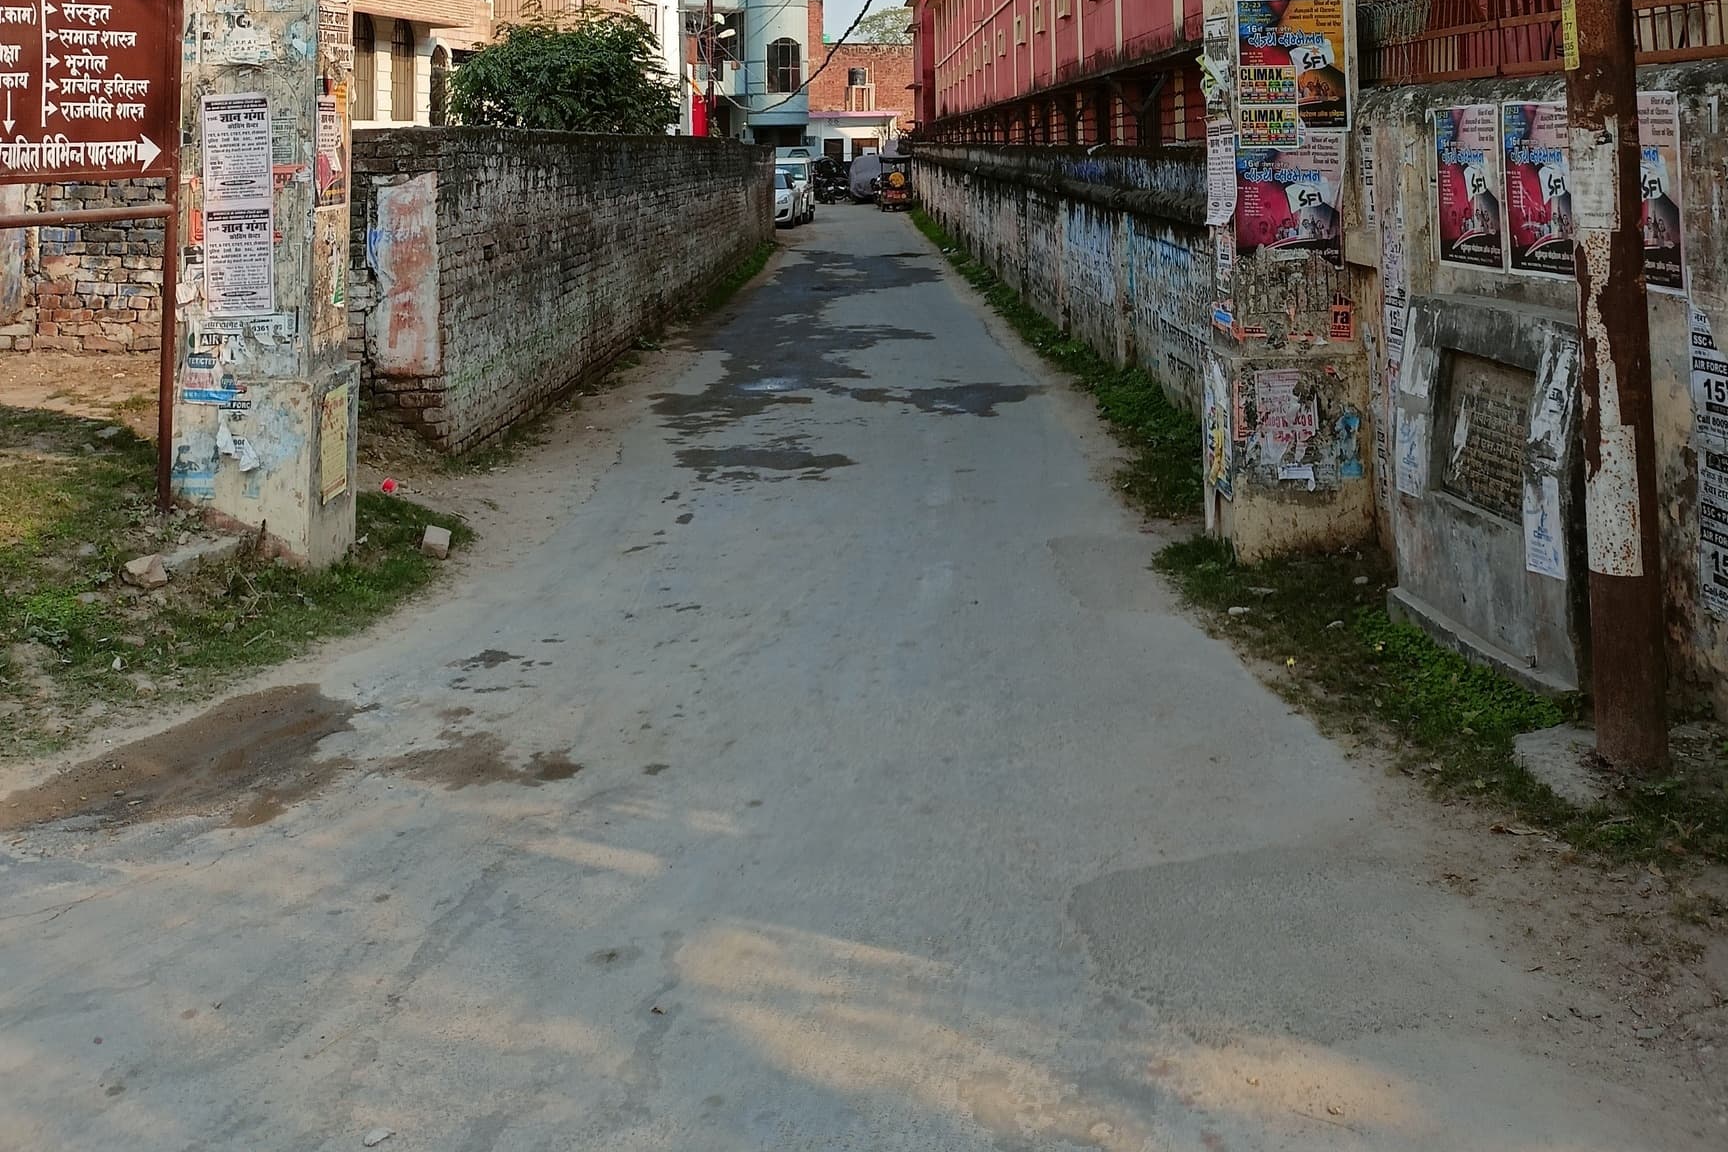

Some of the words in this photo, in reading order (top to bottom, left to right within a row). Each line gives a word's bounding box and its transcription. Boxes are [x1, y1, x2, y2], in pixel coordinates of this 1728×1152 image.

[62, 0, 112, 26] संस्कृत
[58, 28, 98, 47] समाज
[100, 30, 137, 48] शास्त्र
[64, 48, 108, 77] भूगोल
[1303, 52, 1327, 69] SFI
[1241, 68, 1282, 81] CLIMAX
[60, 73, 100, 96] प्राचीन
[103, 76, 150, 100] इतिहास
[61, 98, 113, 122] राजनीति
[116, 101, 145, 120] शास्त्र
[243, 109, 266, 121] गंगा
[1241, 109, 1283, 122] CLIMAX
[41, 133, 85, 169] विभिन्न
[87, 139, 138, 172] पाठ्यक्रम
[1472, 175, 1486, 194] SFI
[1549, 175, 1566, 196] SFI
[1298, 190, 1322, 207] SFI
[245, 220, 267, 231] गंगा
[1693, 334, 1707, 346] SSC
[1695, 360, 1706, 370] AIR
